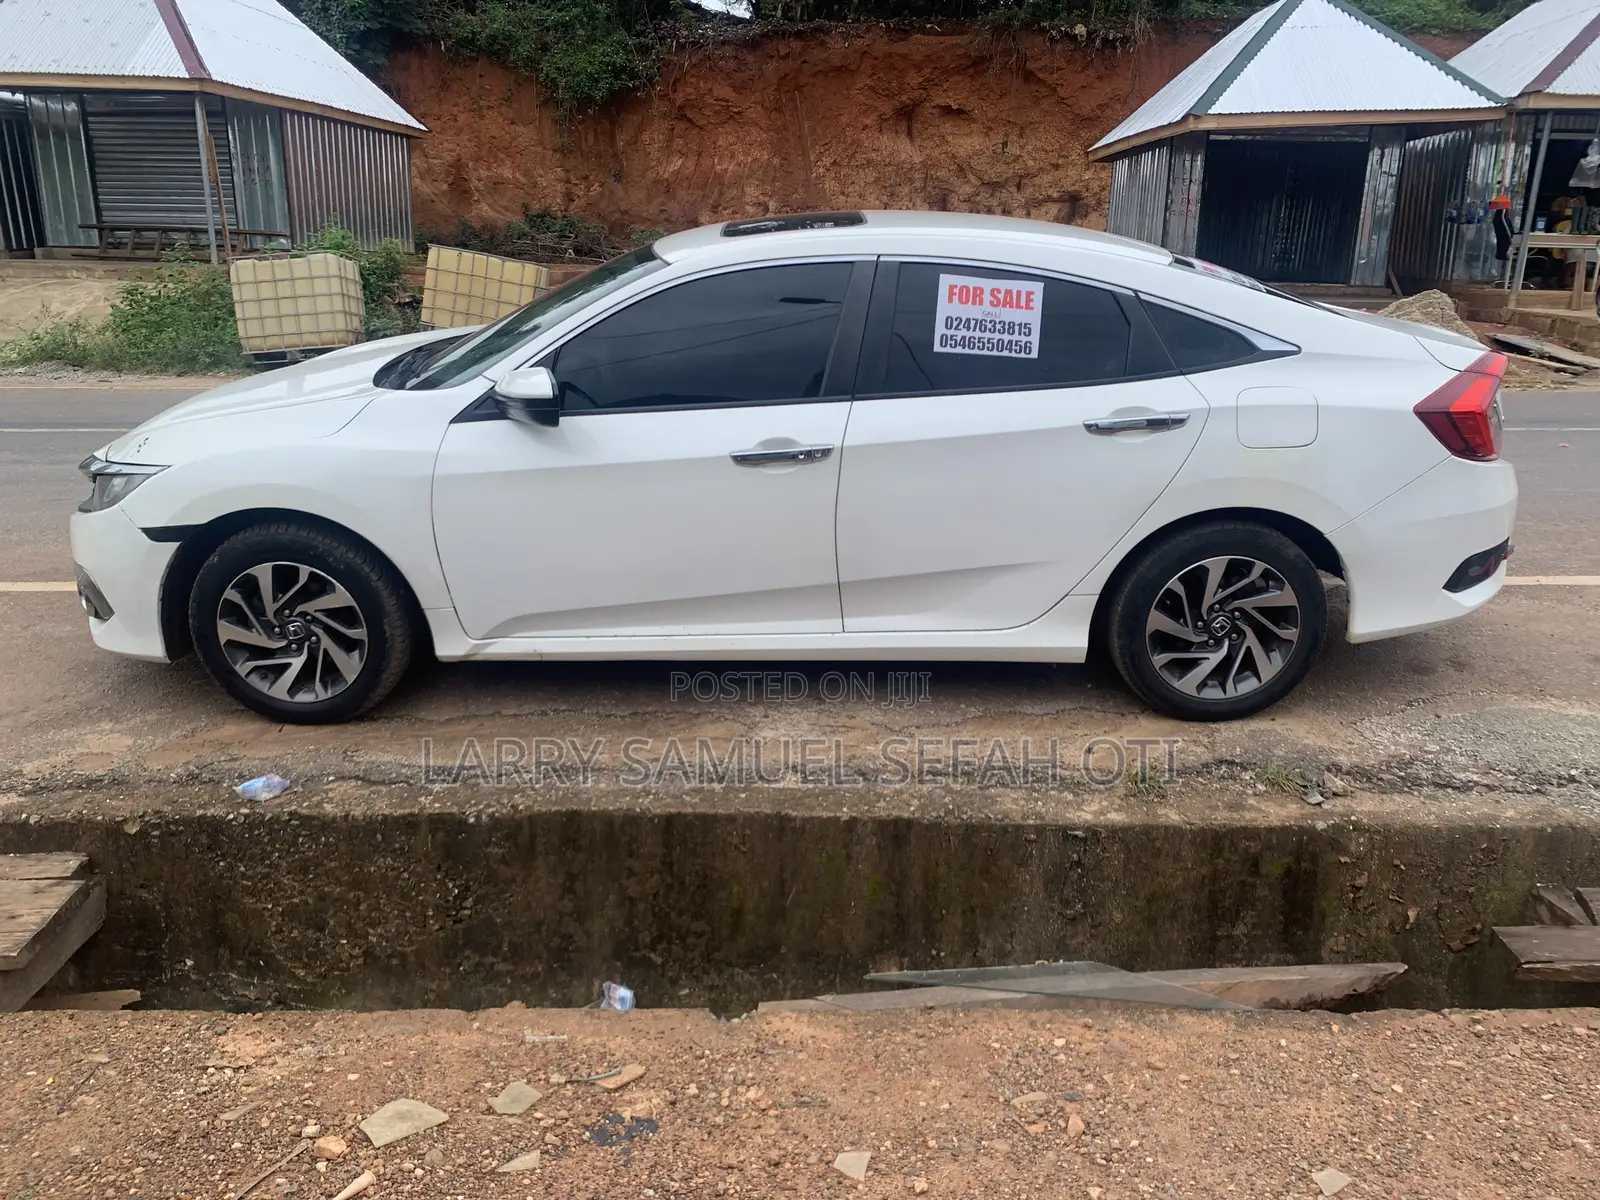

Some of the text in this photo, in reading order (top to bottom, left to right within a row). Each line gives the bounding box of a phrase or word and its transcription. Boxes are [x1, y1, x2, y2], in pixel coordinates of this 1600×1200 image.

[948, 284, 1035, 310] FOR SALE
[945, 316, 1032, 337] 0247633815
[940, 333, 1033, 355] 0546550456
